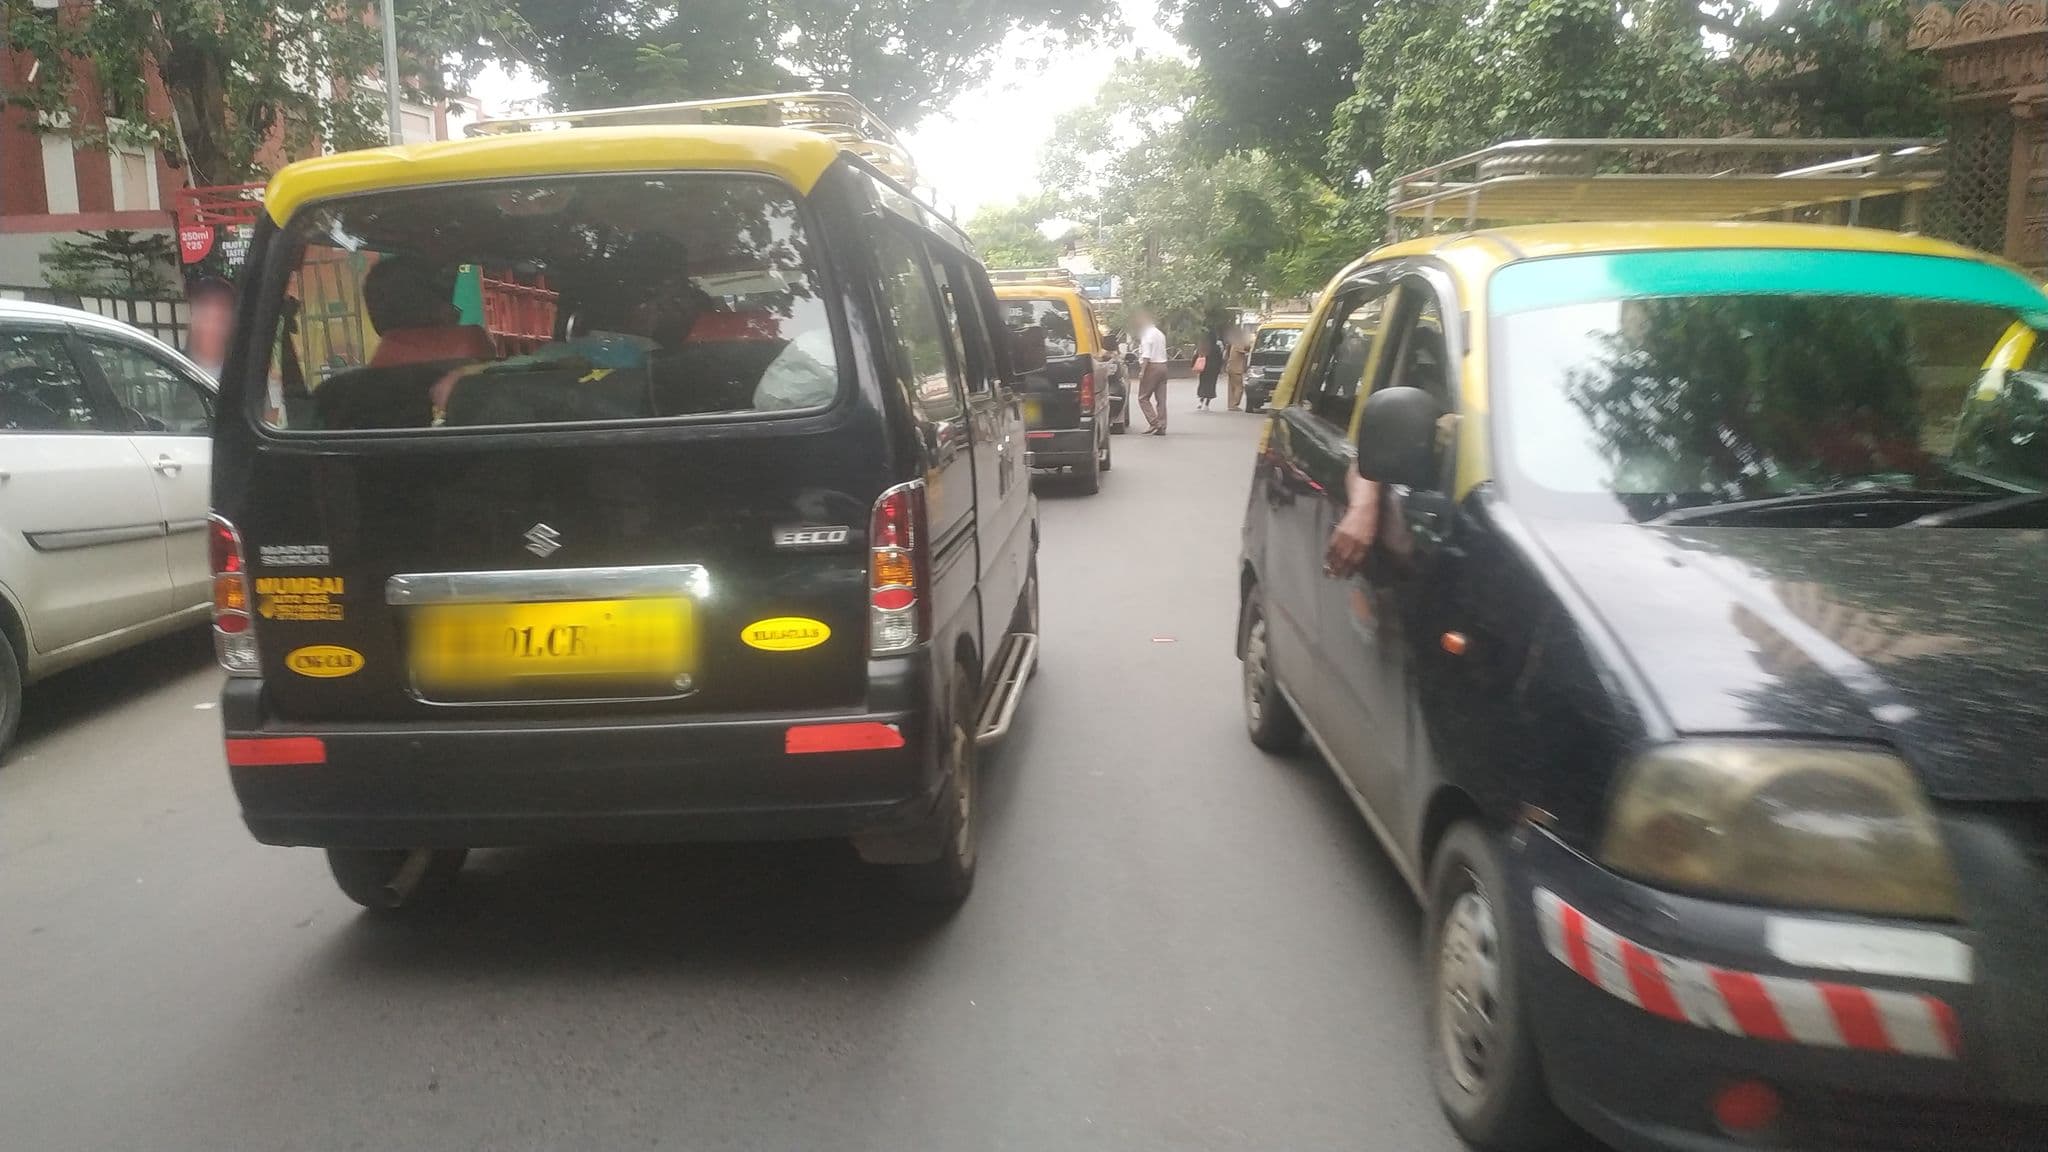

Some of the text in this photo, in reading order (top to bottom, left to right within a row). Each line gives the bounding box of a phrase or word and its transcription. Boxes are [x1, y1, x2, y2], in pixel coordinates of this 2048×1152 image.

[182, 231, 209, 241] 250ml
[226, 249, 245, 257] TASTE
[776, 530, 848, 544] EECO
[260, 545, 329, 555] MARUTI
[260, 555, 329, 567] SUZUKI
[256, 577, 344, 595] MUMBAI
